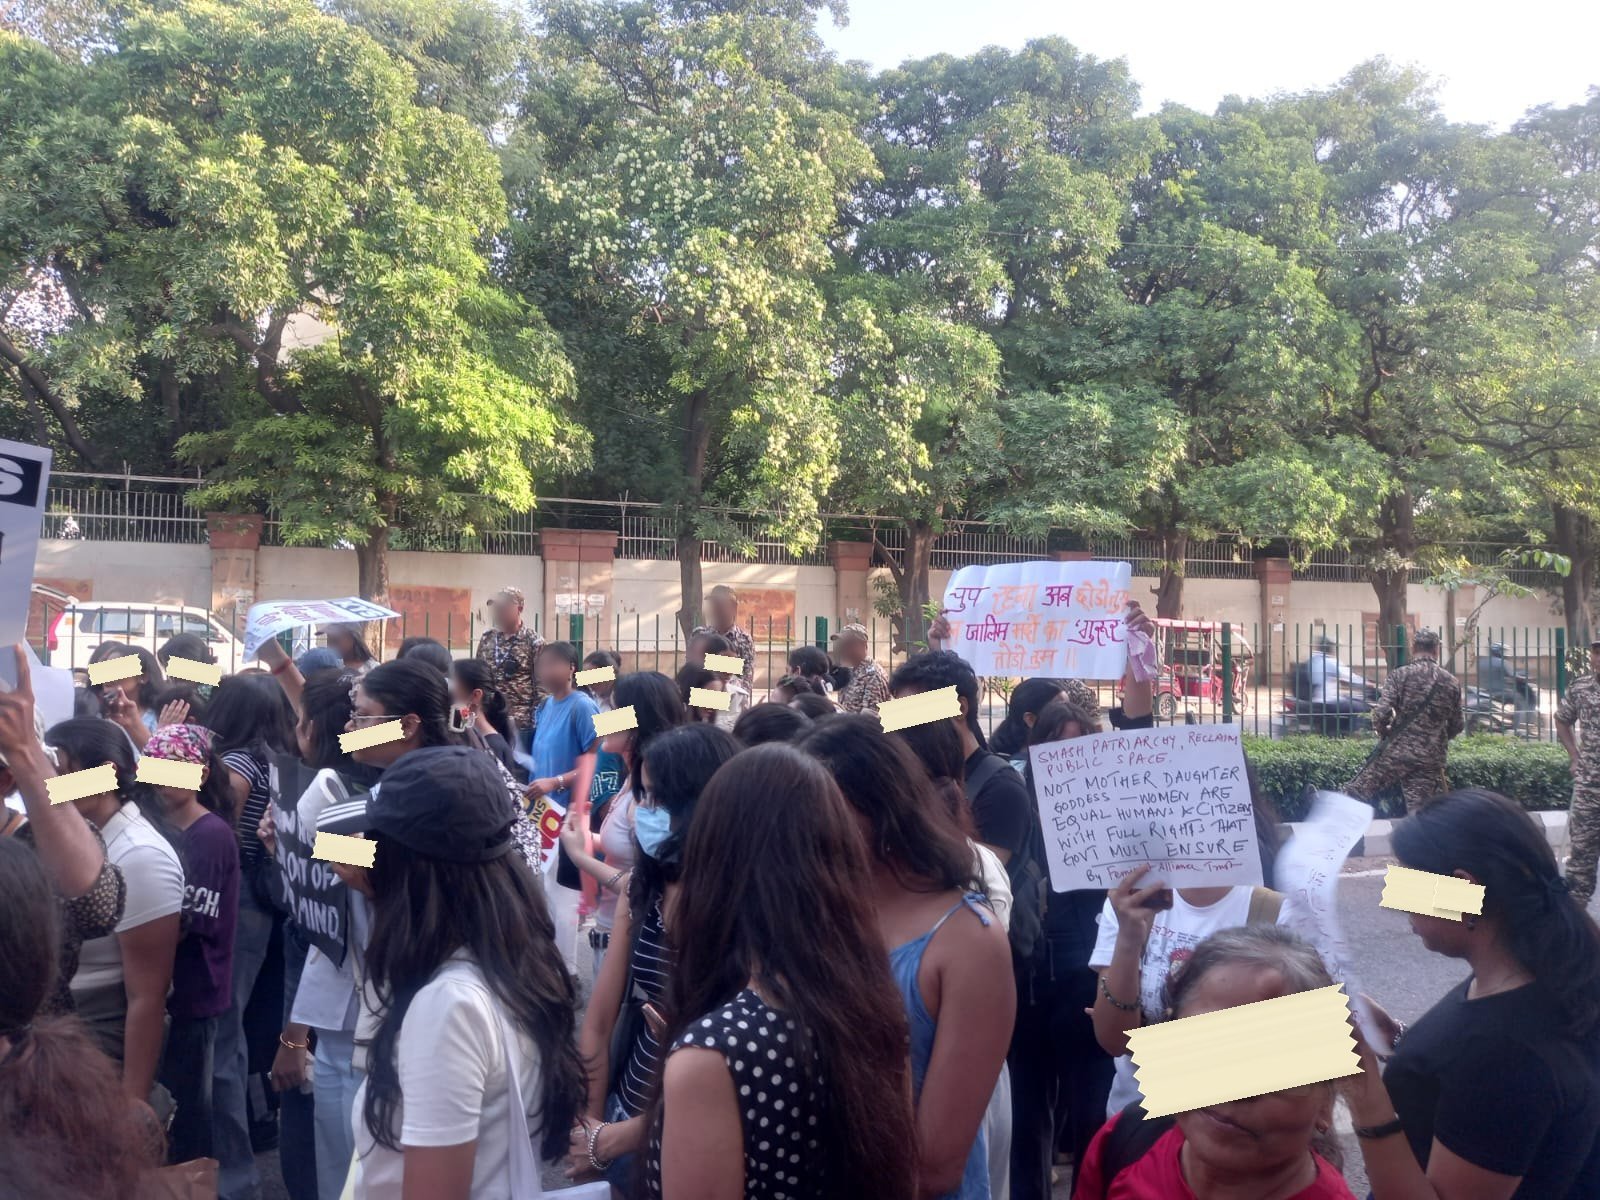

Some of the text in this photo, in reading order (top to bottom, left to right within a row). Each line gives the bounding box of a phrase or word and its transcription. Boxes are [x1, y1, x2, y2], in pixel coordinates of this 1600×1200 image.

[942, 586, 990, 614] चुप
[1042, 584, 1074, 608] अब
[1044, 618, 1070, 644] का
[1038, 744, 1084, 764] SMASH
[1188, 731, 1238, 747] RECLAIM
[1047, 756, 1103, 778] PUBLIC
[1044, 766, 1240, 797] NOT MOTHER DAUGHTER
[1054, 792, 1111, 815] GODDESS
[1200, 785, 1233, 802] ARE
[1052, 808, 1112, 836] EQUAL
[1106, 825, 1141, 842] FULL
[1210, 818, 1248, 834] THAT
[1063, 839, 1249, 867] GOVT MUST ENSURE
